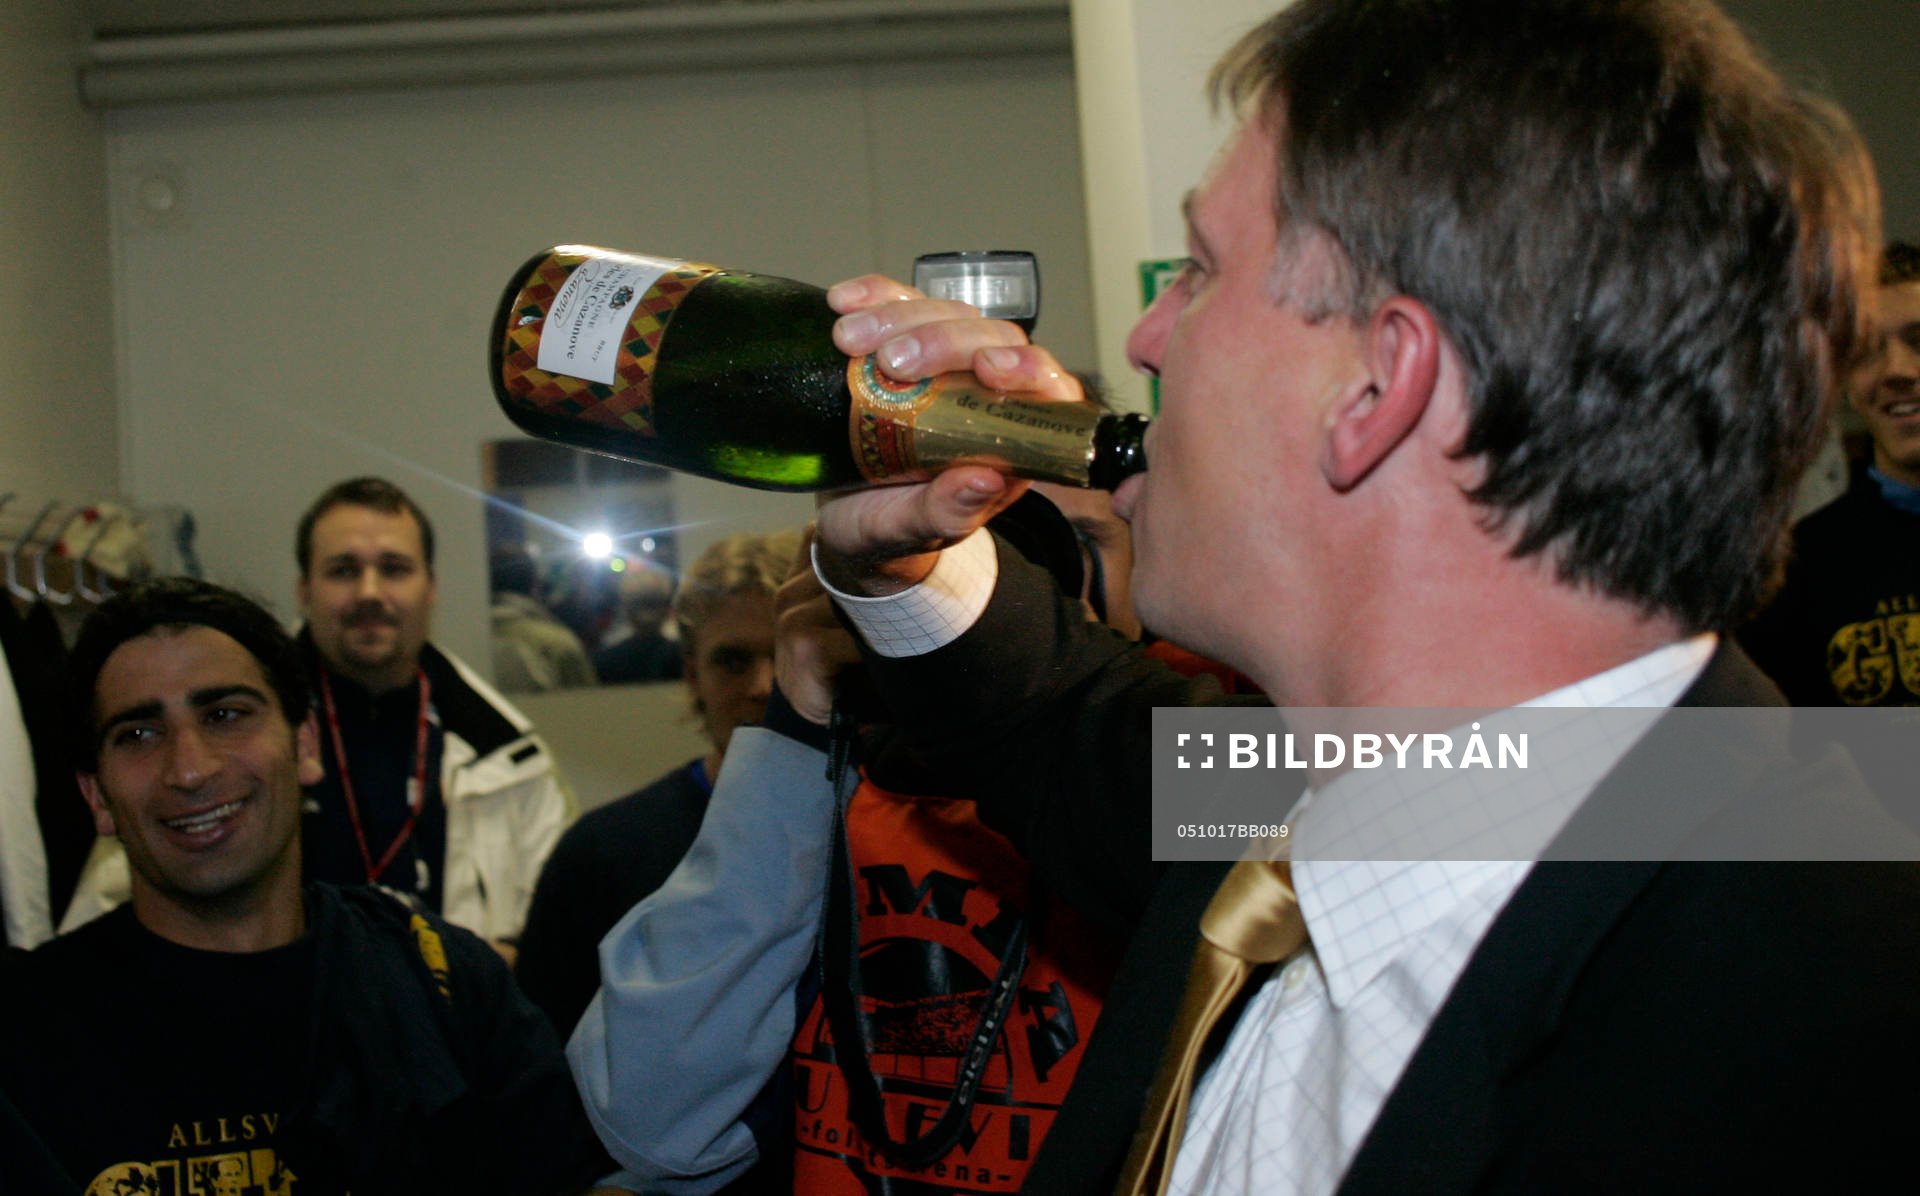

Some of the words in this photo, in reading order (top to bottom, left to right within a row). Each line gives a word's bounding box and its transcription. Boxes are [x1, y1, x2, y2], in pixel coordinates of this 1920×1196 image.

[567, 296, 599, 360] Cazanove
[591, 338, 607, 363] BRUT
[956, 393, 979, 411] de
[986, 402, 1087, 437] Cazanove
